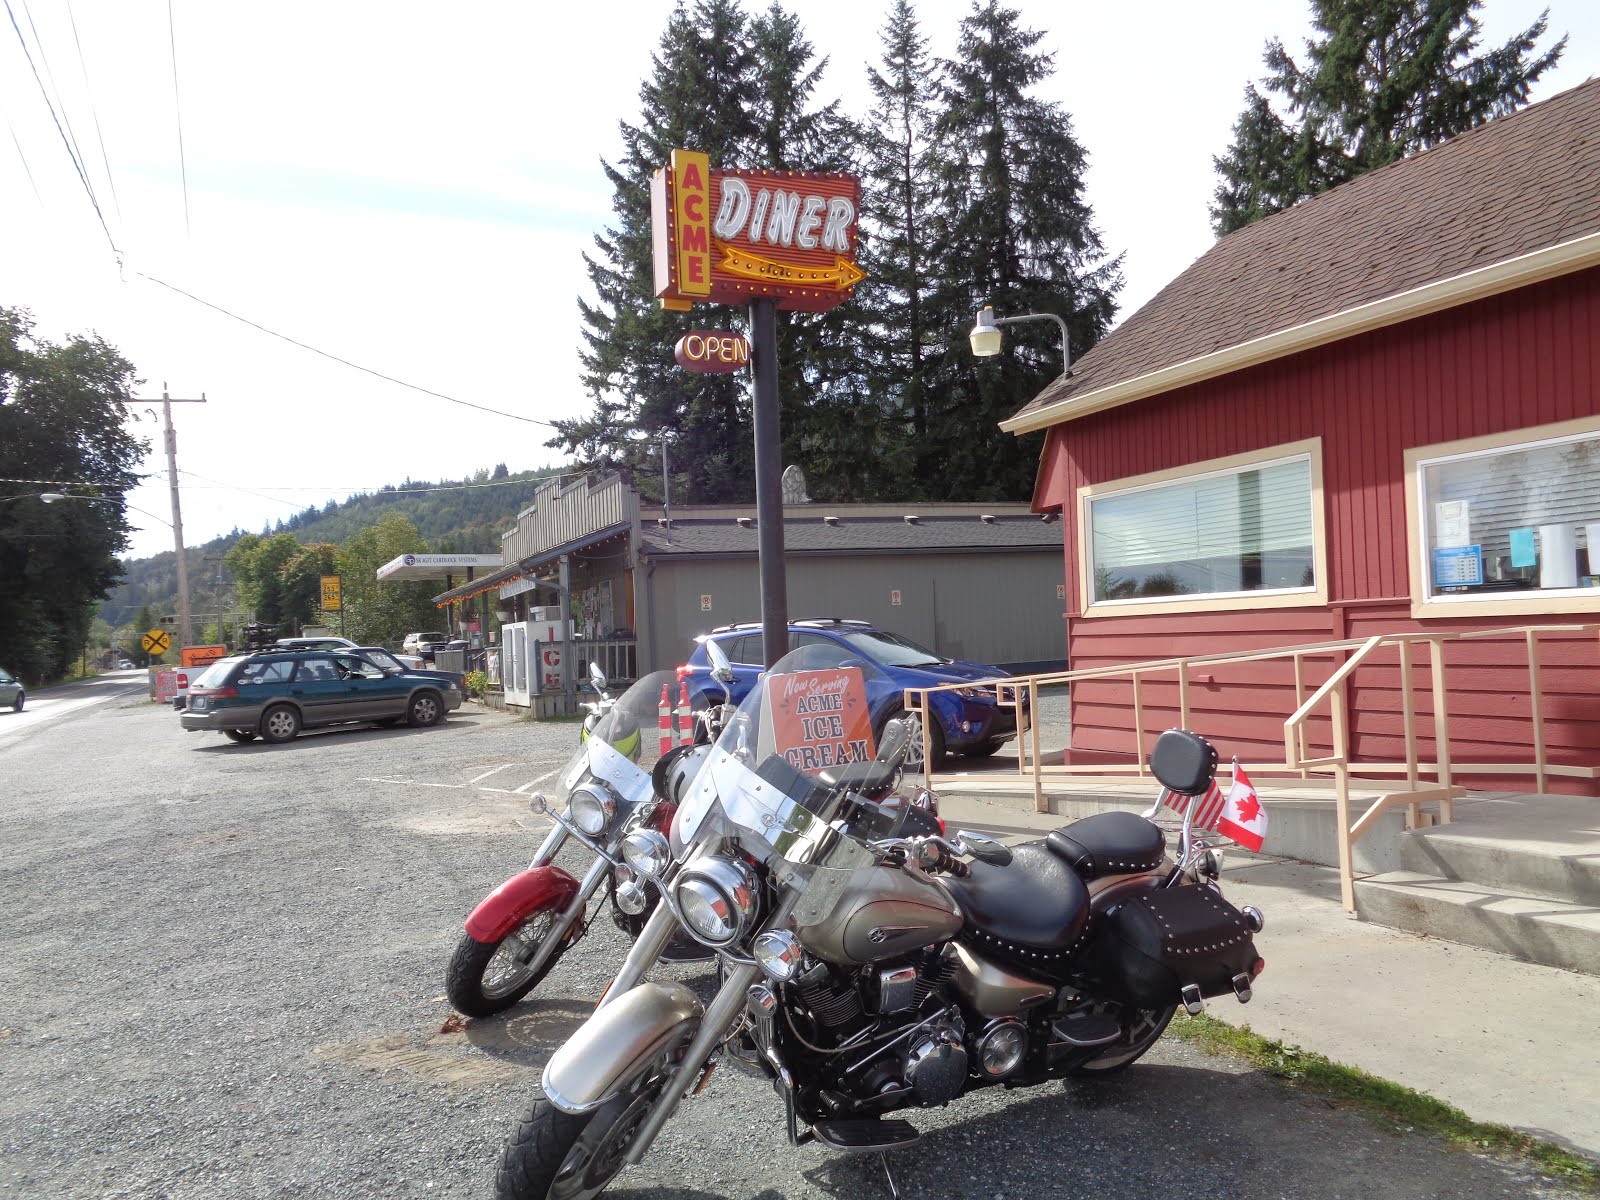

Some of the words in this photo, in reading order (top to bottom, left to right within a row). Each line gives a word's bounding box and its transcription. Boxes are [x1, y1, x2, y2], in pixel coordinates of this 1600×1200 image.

[682, 164, 707, 283] ACME
[713, 177, 854, 253] DINER
[685, 335, 747, 363] OPEN
[784, 676, 807, 697] Now
[807, 675, 849, 696] Serving
[797, 693, 843, 714] ACME
[802, 715, 844, 741] ICE
[785, 740, 869, 770] CREAM
